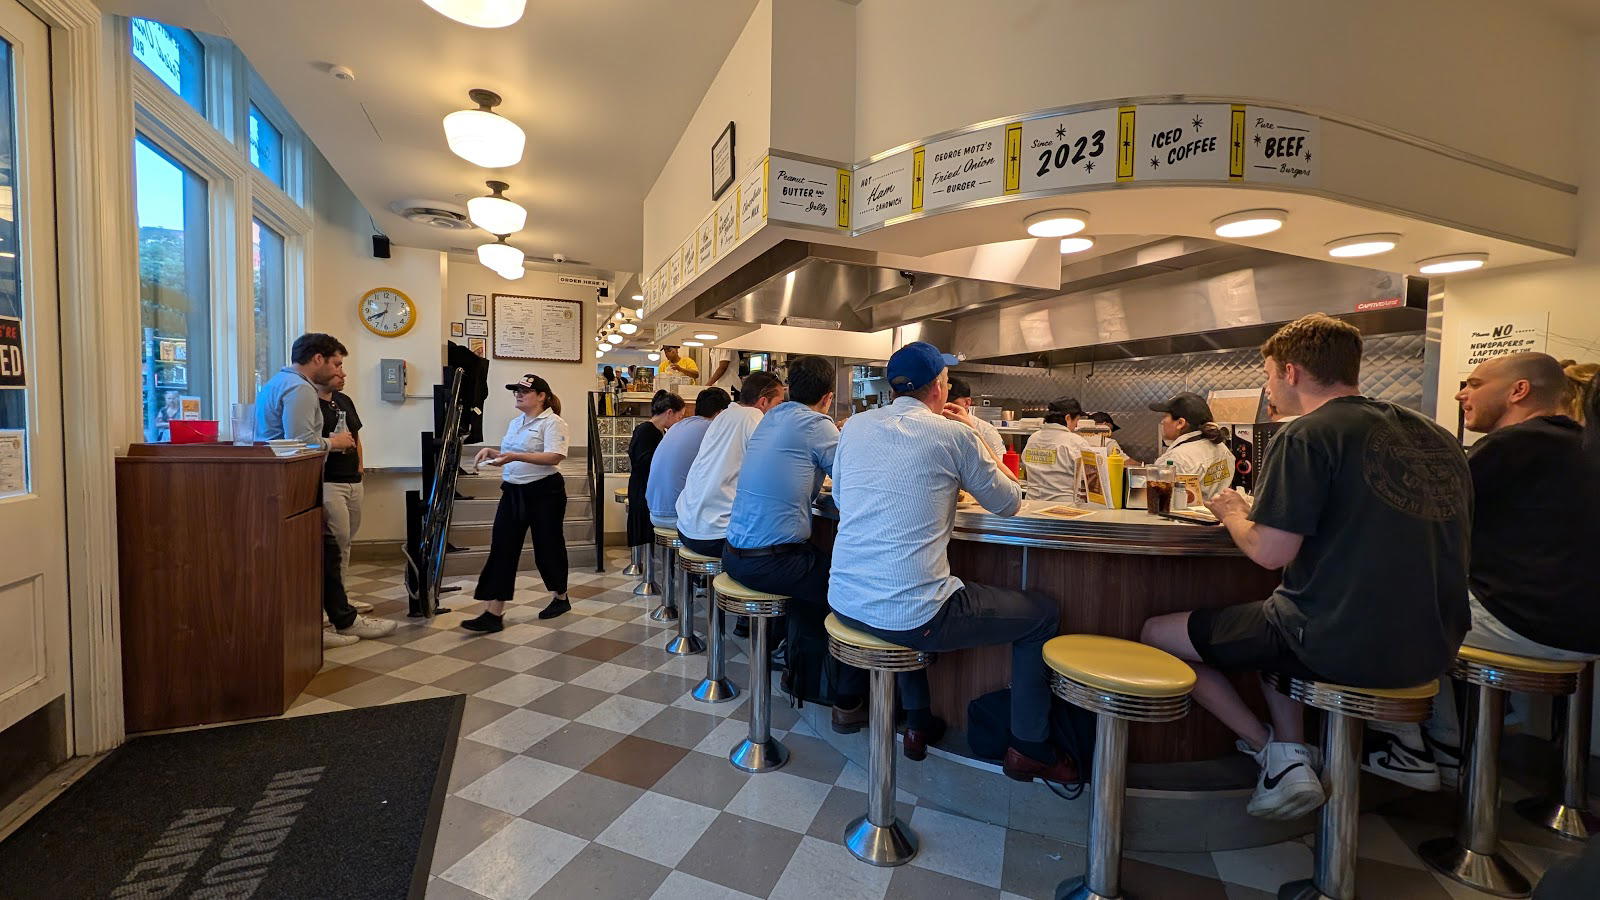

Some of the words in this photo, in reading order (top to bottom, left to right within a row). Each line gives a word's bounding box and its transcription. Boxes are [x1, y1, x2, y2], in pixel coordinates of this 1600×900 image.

[1255, 117, 1275, 130] Pure
[1030, 138, 1054, 149] Since
[1151, 127, 1183, 149] ICED
[934, 147, 962, 163] GEORGE
[963, 141, 993, 157] MOTZ'S
[1036, 129, 1106, 178] 2023
[1167, 136, 1217, 165] COFFEE
[1264, 136, 1306, 159] BEEF
[777, 170, 806, 185] Peanut
[932, 163, 961, 187] Fried
[963, 155, 997, 174] Onion
[1279, 163, 1311, 178] Burgers
[860, 176, 872, 188] HOT
[946, 180, 977, 194] BURGER
[782, 186, 814, 198] BUTTER
[866, 183, 896, 206] Ham
[804, 201, 829, 216] Jelly
[874, 197, 903, 212] SANDWICH
[1492, 323, 1513, 338] NO
[1470, 339, 1524, 350] NEWSPAPERS
[1472, 348, 1509, 357] LAPTOPS
